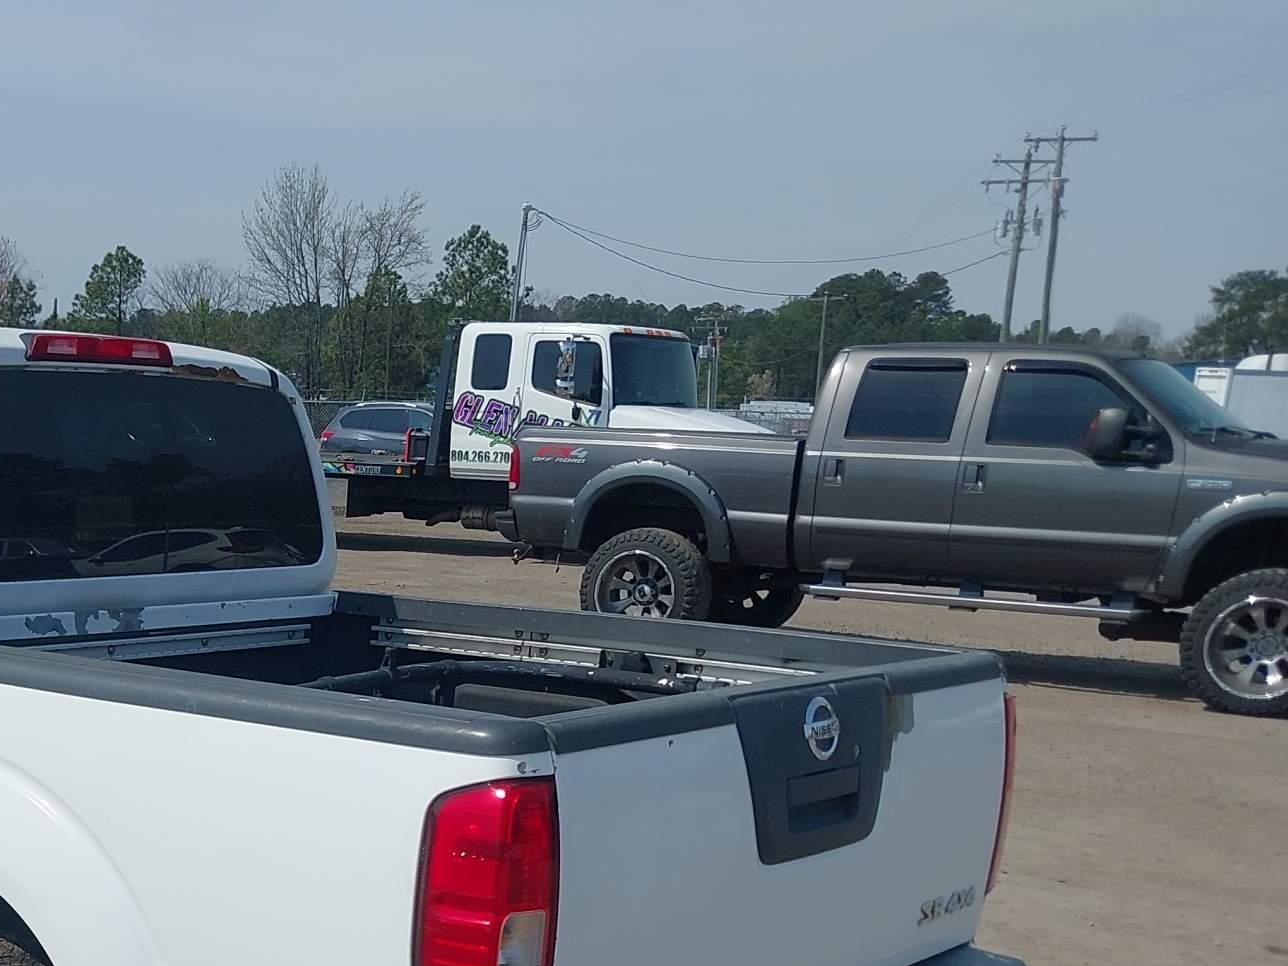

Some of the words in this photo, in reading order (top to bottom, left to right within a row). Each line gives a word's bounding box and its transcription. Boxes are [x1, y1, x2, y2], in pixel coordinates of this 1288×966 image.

[453, 391, 519, 438] GLEN
[451, 449, 510, 464] 804.266.270
[355, 465, 382, 474] CENTURY
